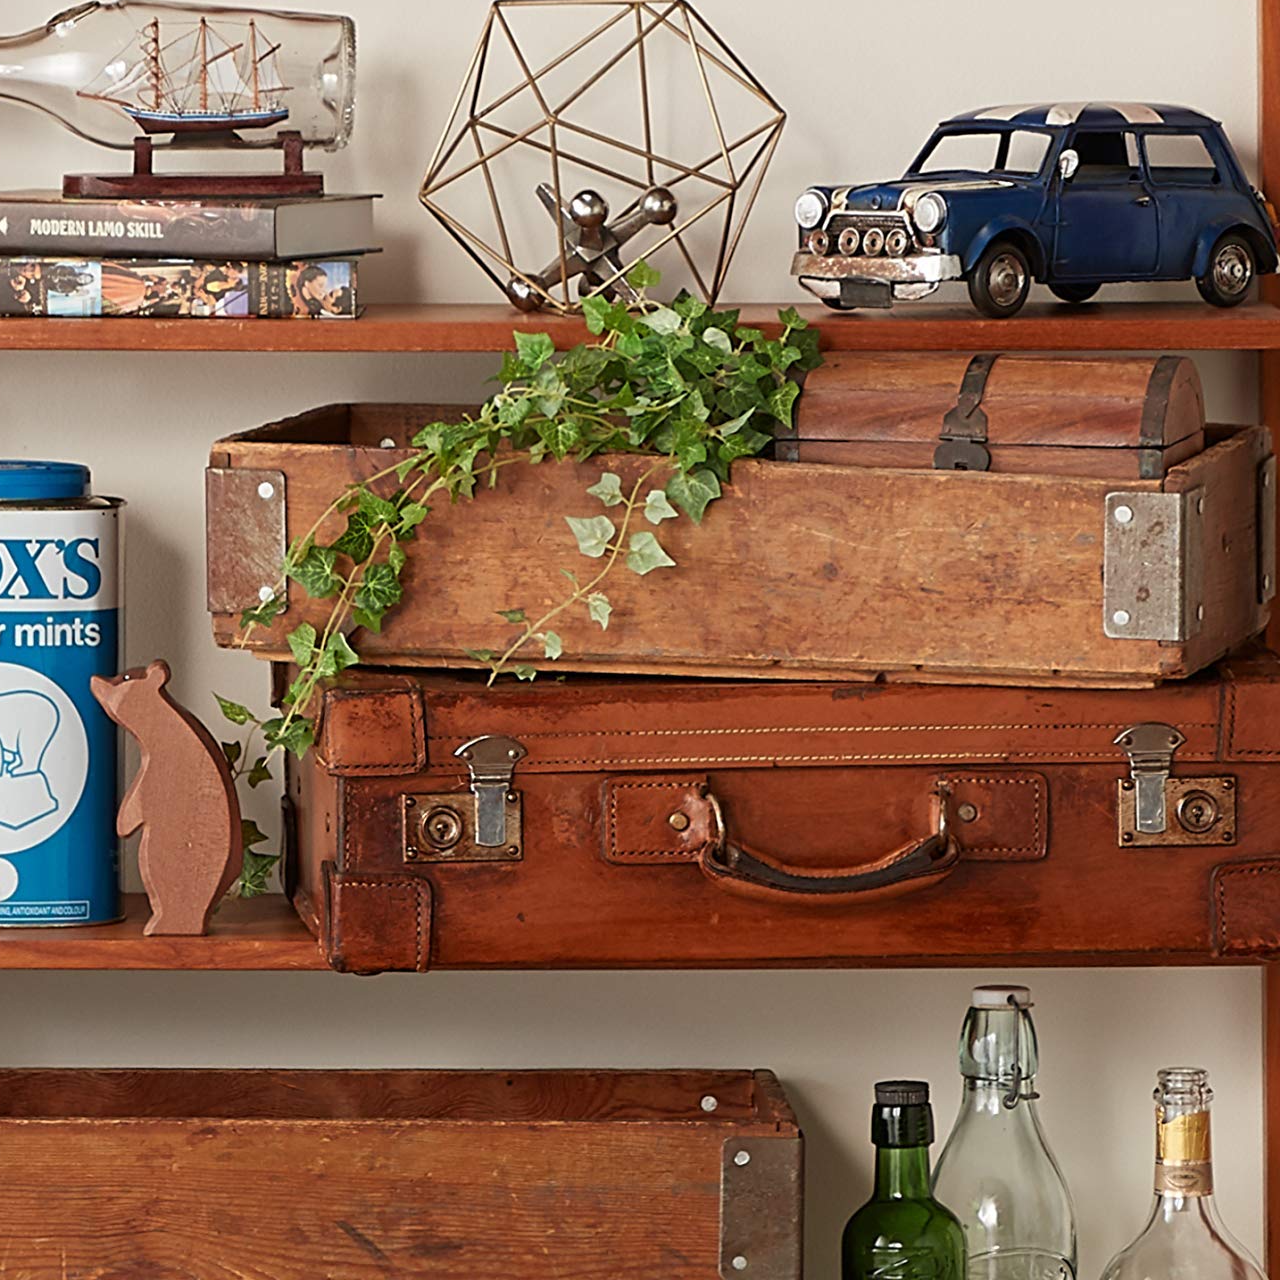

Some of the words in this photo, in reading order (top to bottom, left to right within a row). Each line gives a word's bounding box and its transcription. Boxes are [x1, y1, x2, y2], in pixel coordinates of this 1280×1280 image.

[29, 218, 86, 237] MODERN
[127, 221, 164, 239] SKILL
[14, 616, 102, 648] mints
